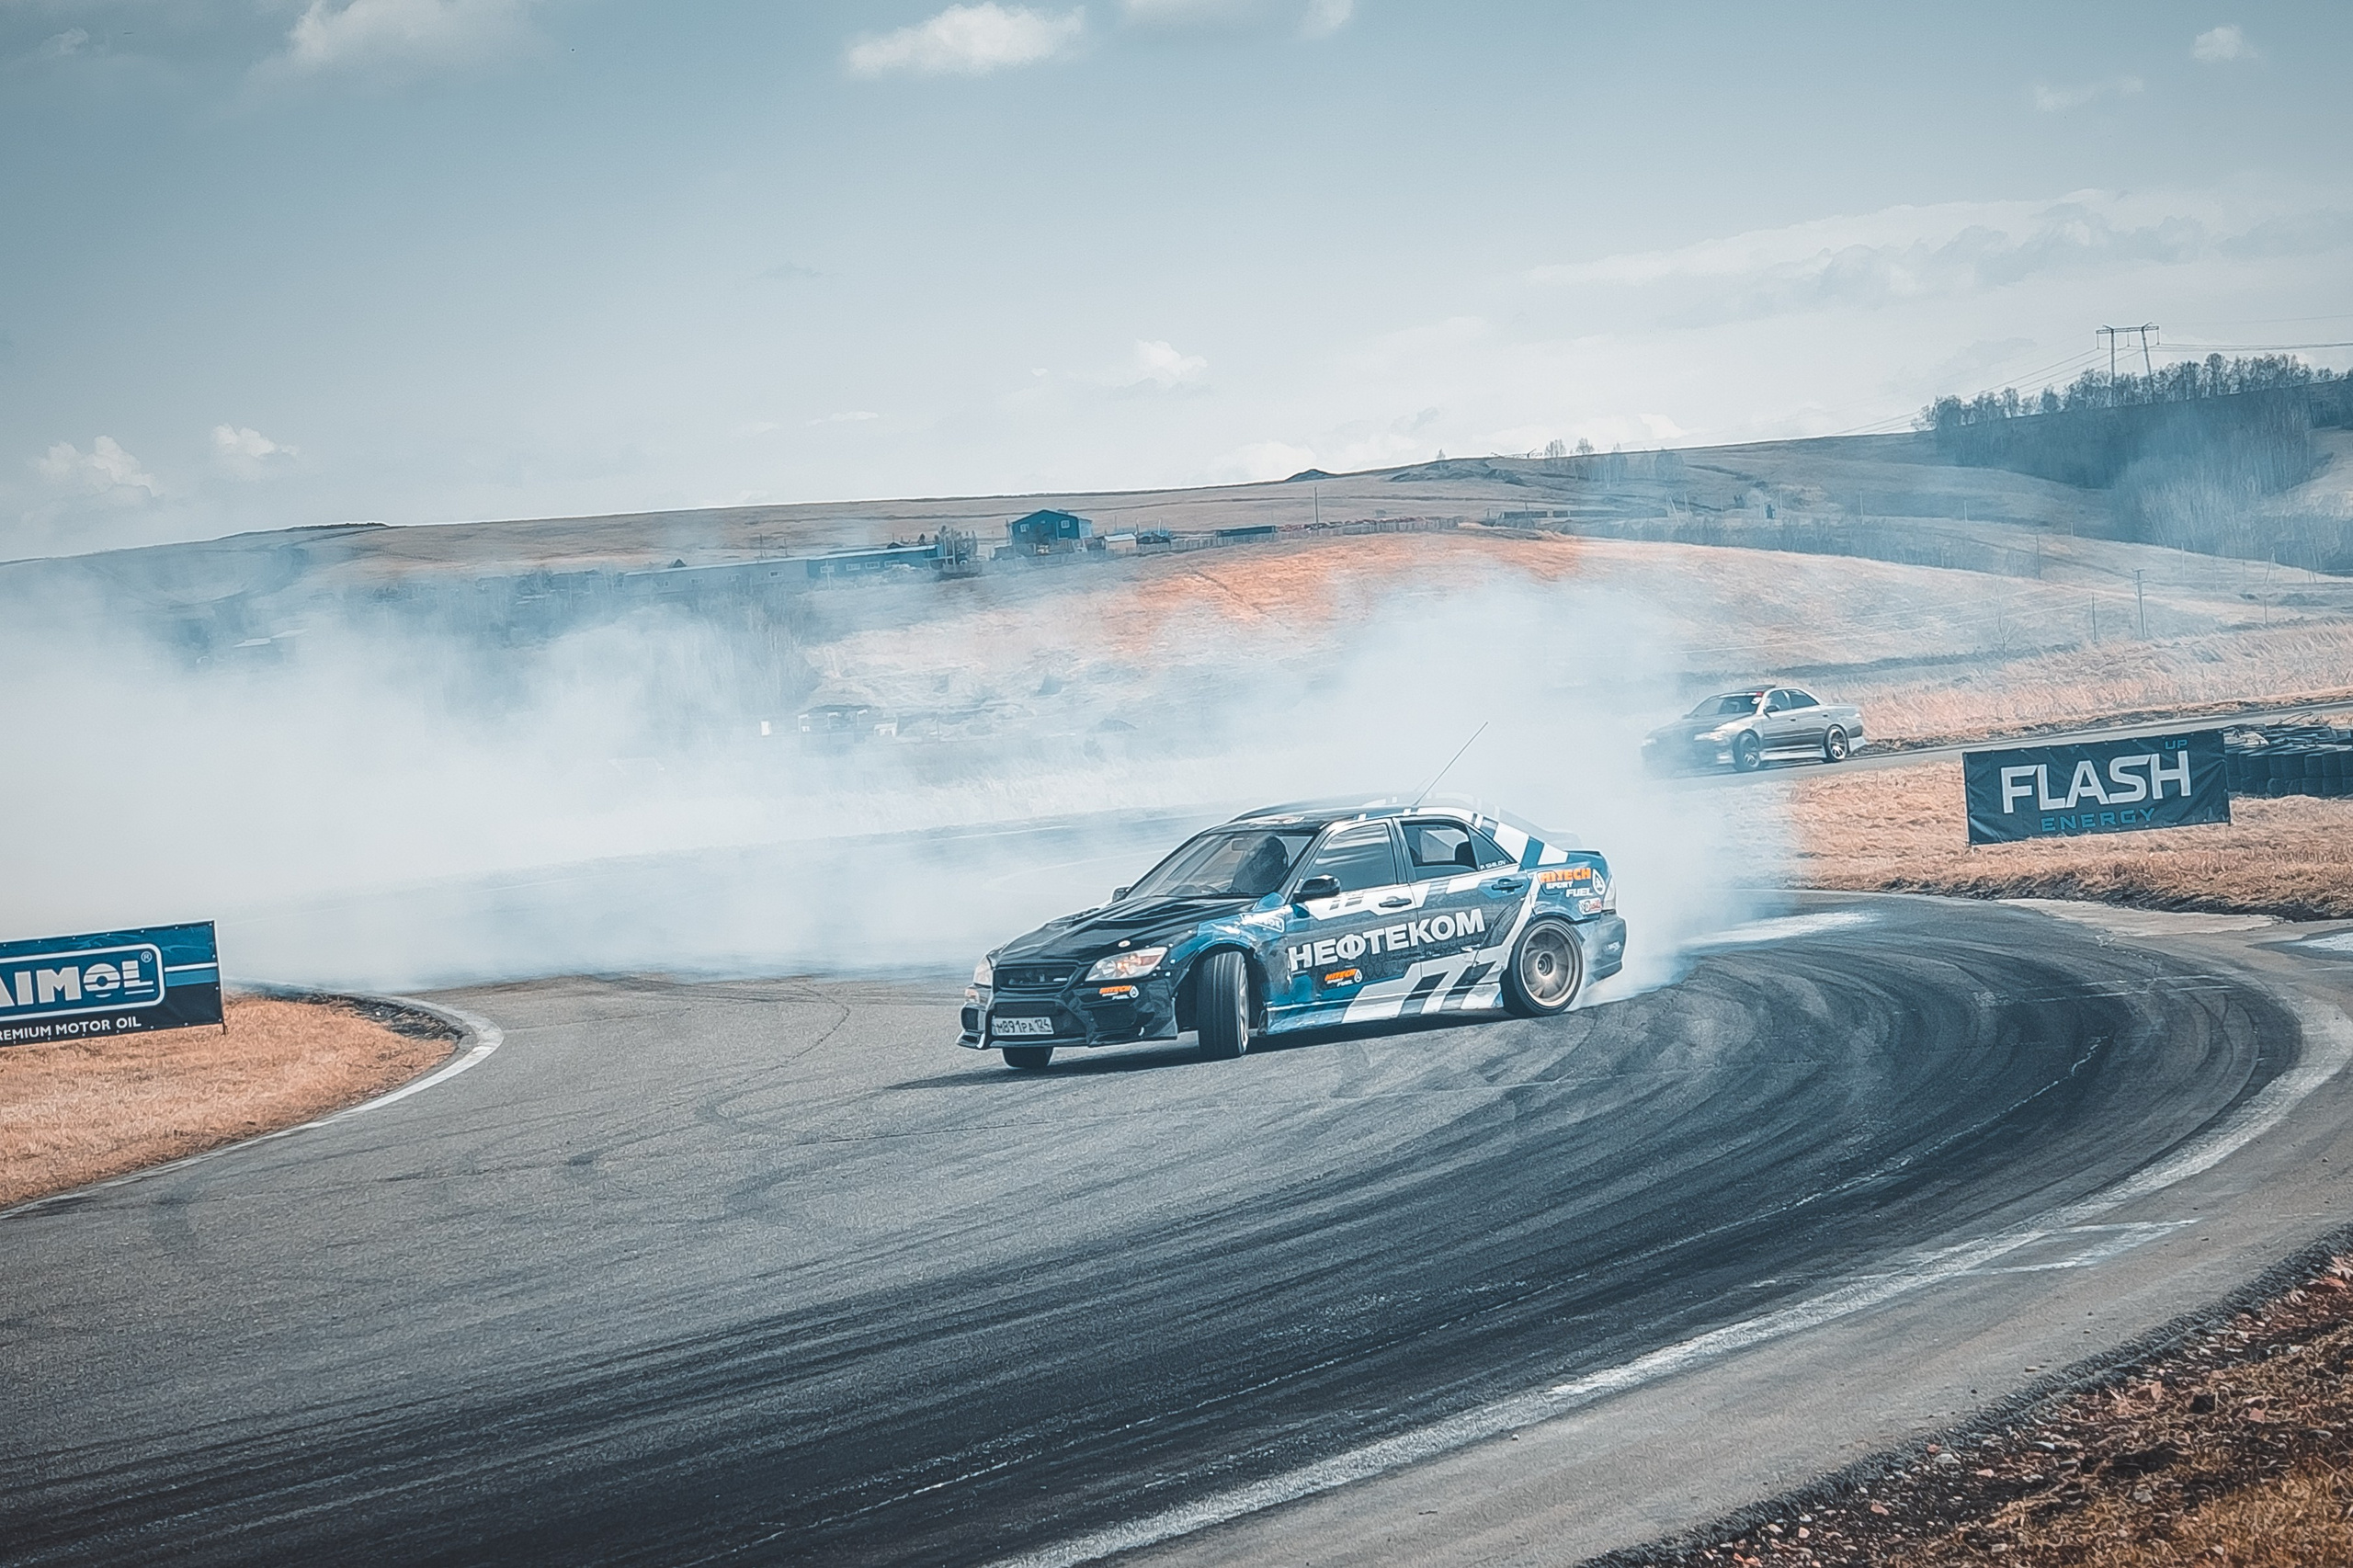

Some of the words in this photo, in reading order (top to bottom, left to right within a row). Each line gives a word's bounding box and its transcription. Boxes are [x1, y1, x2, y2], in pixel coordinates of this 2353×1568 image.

[2165, 739, 2188, 750] UP
[2000, 750, 2191, 814] FLASH
[2040, 808, 2155, 832] ENERGY
[1540, 867, 1592, 883] HITECH
[1546, 881, 1574, 890] SPORT
[1565, 887, 1594, 898] FUEL
[1288, 908, 1486, 971] НЕФТЕКОМ
[56, 1019, 111, 1036] MOTOR
[116, 1016, 142, 1029] OIL
